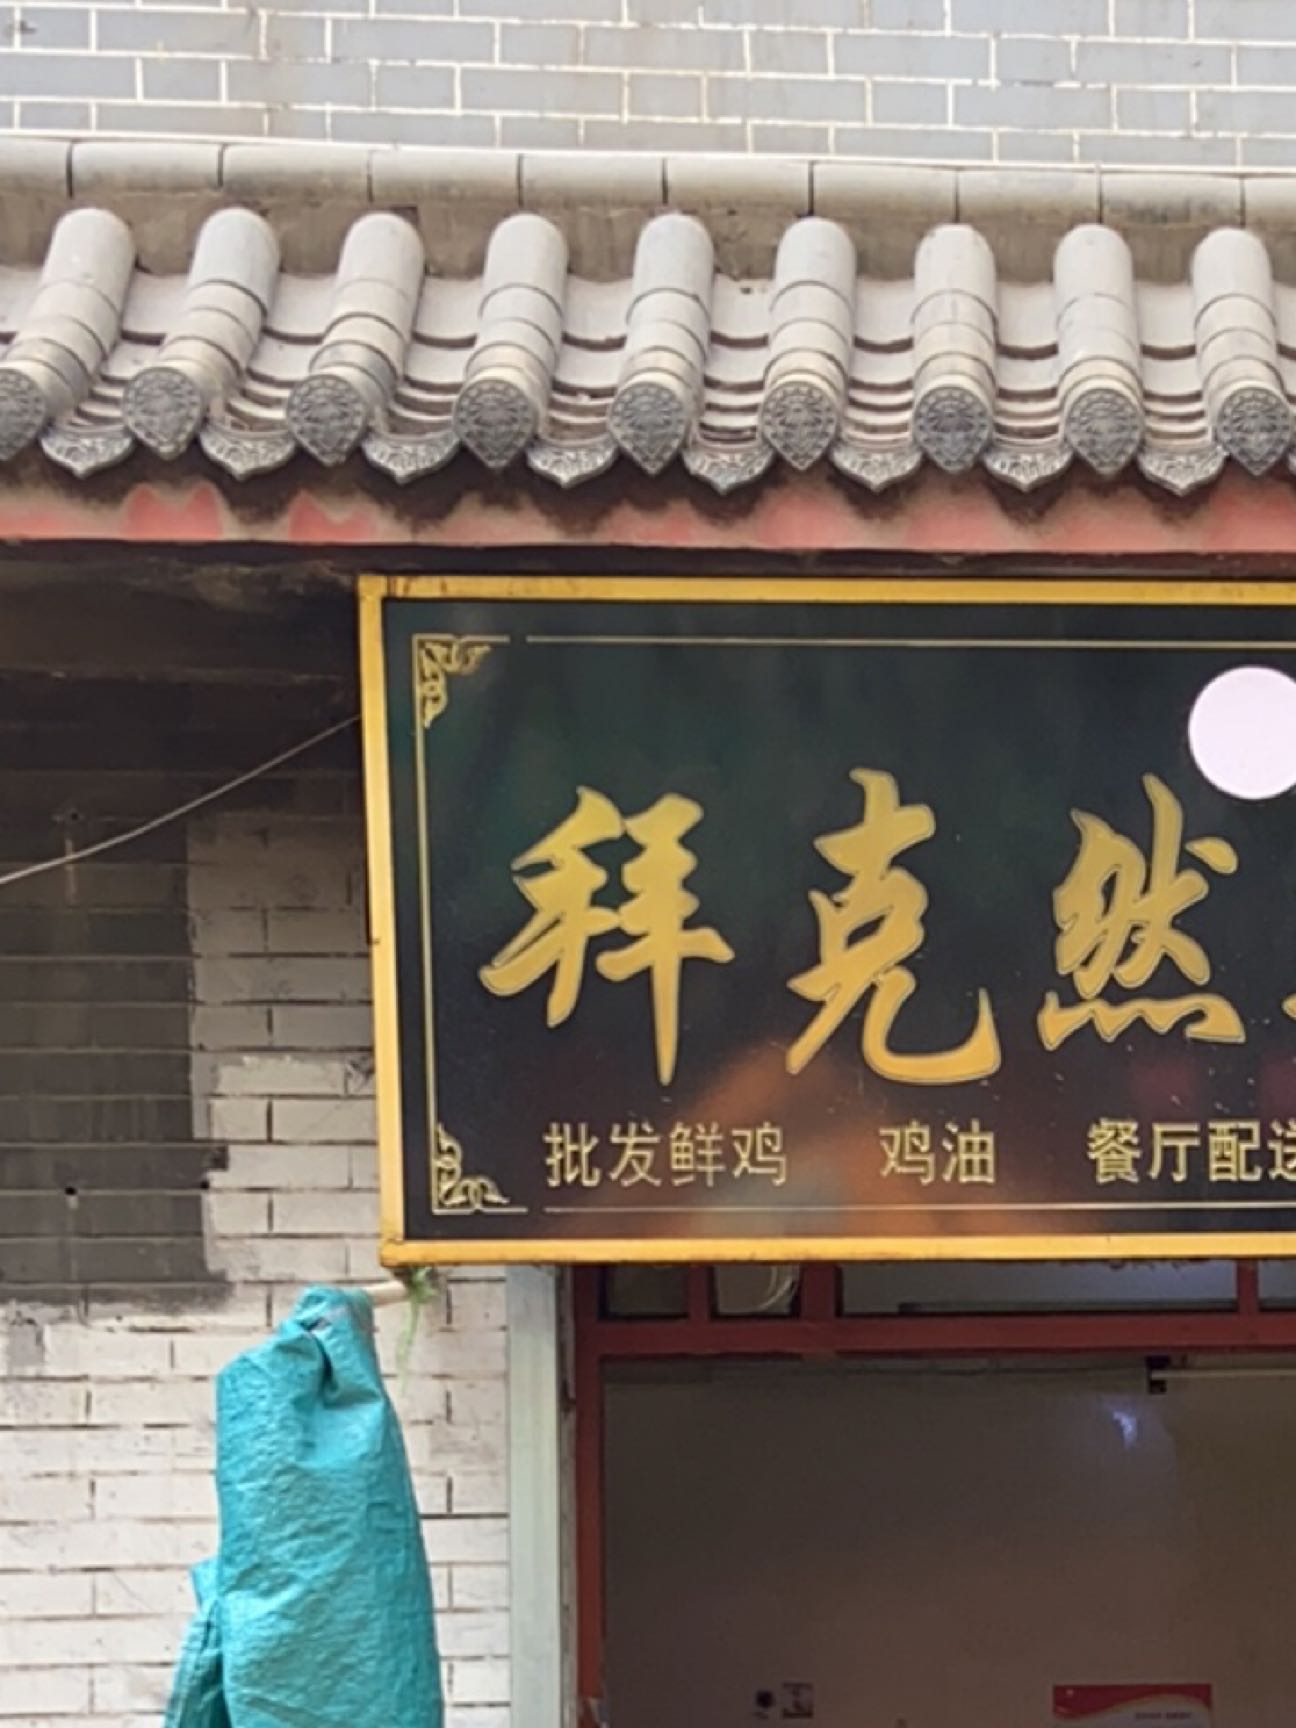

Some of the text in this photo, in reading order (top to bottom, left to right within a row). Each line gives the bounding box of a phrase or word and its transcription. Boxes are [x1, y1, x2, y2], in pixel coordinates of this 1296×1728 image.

[543, 1120, 789, 1190] 批发鲜鸡
[879, 1126, 996, 1186] 鸡油
